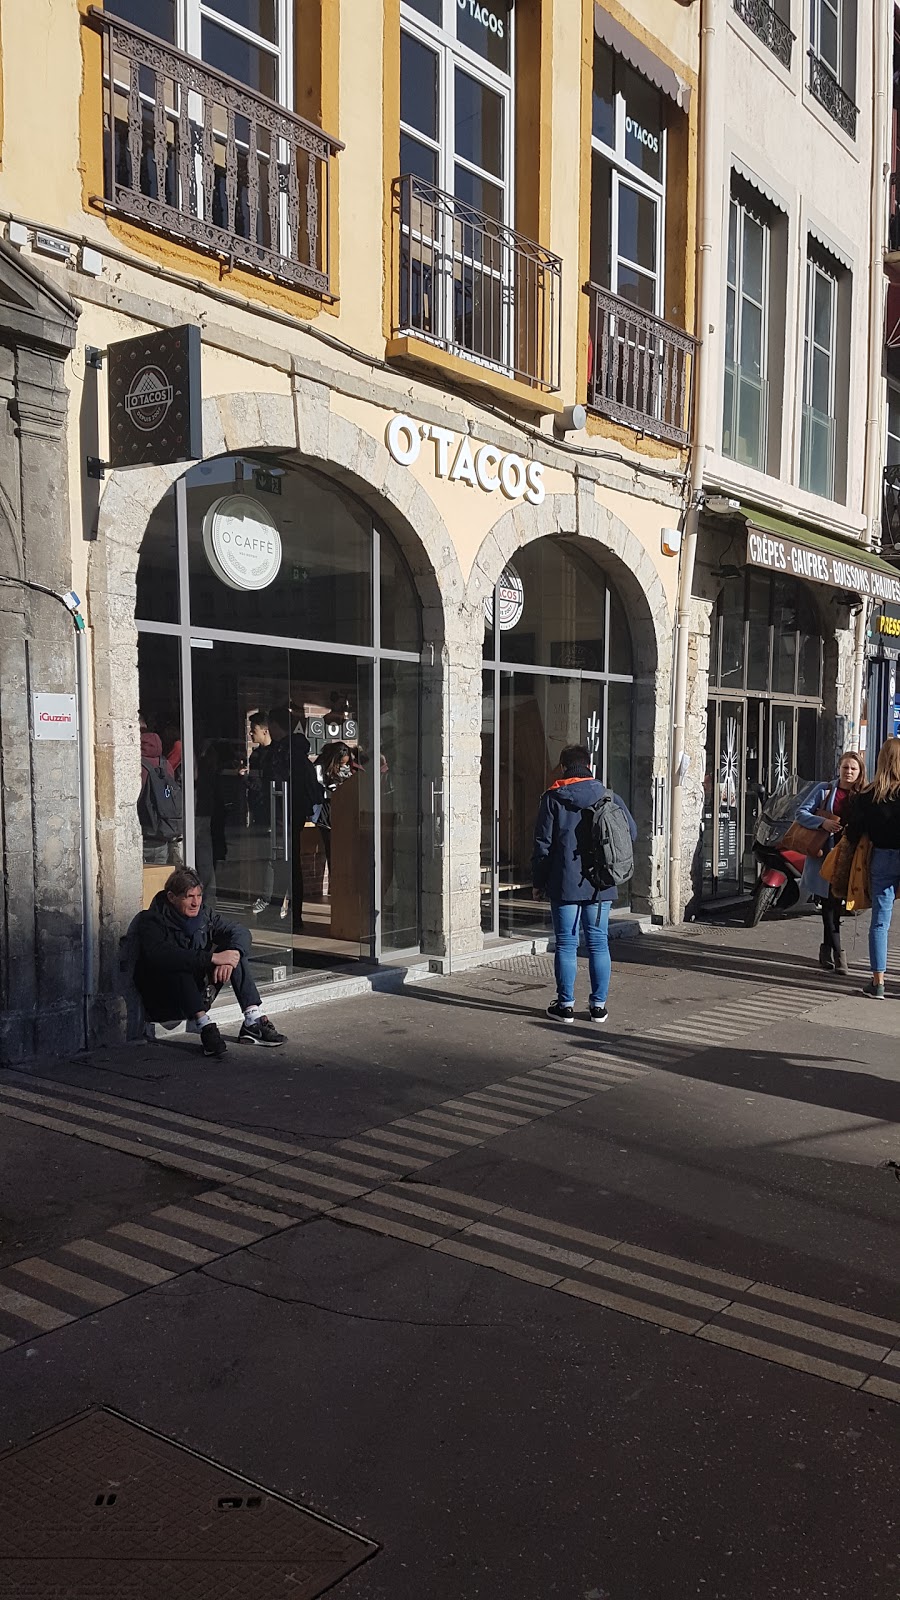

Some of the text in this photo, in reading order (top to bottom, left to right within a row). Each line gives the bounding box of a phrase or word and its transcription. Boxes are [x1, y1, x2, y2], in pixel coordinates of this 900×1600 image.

[625, 116, 659, 153] O'TACOS
[131, 390, 167, 406] O'TACOS
[385, 414, 546, 505] O'TACOS
[749, 533, 787, 570] CRÊPES
[791, 546, 829, 582] GAUFRES
[832, 559, 871, 593] BOISSONS
[39, 712, 72, 722] iGuzzini
